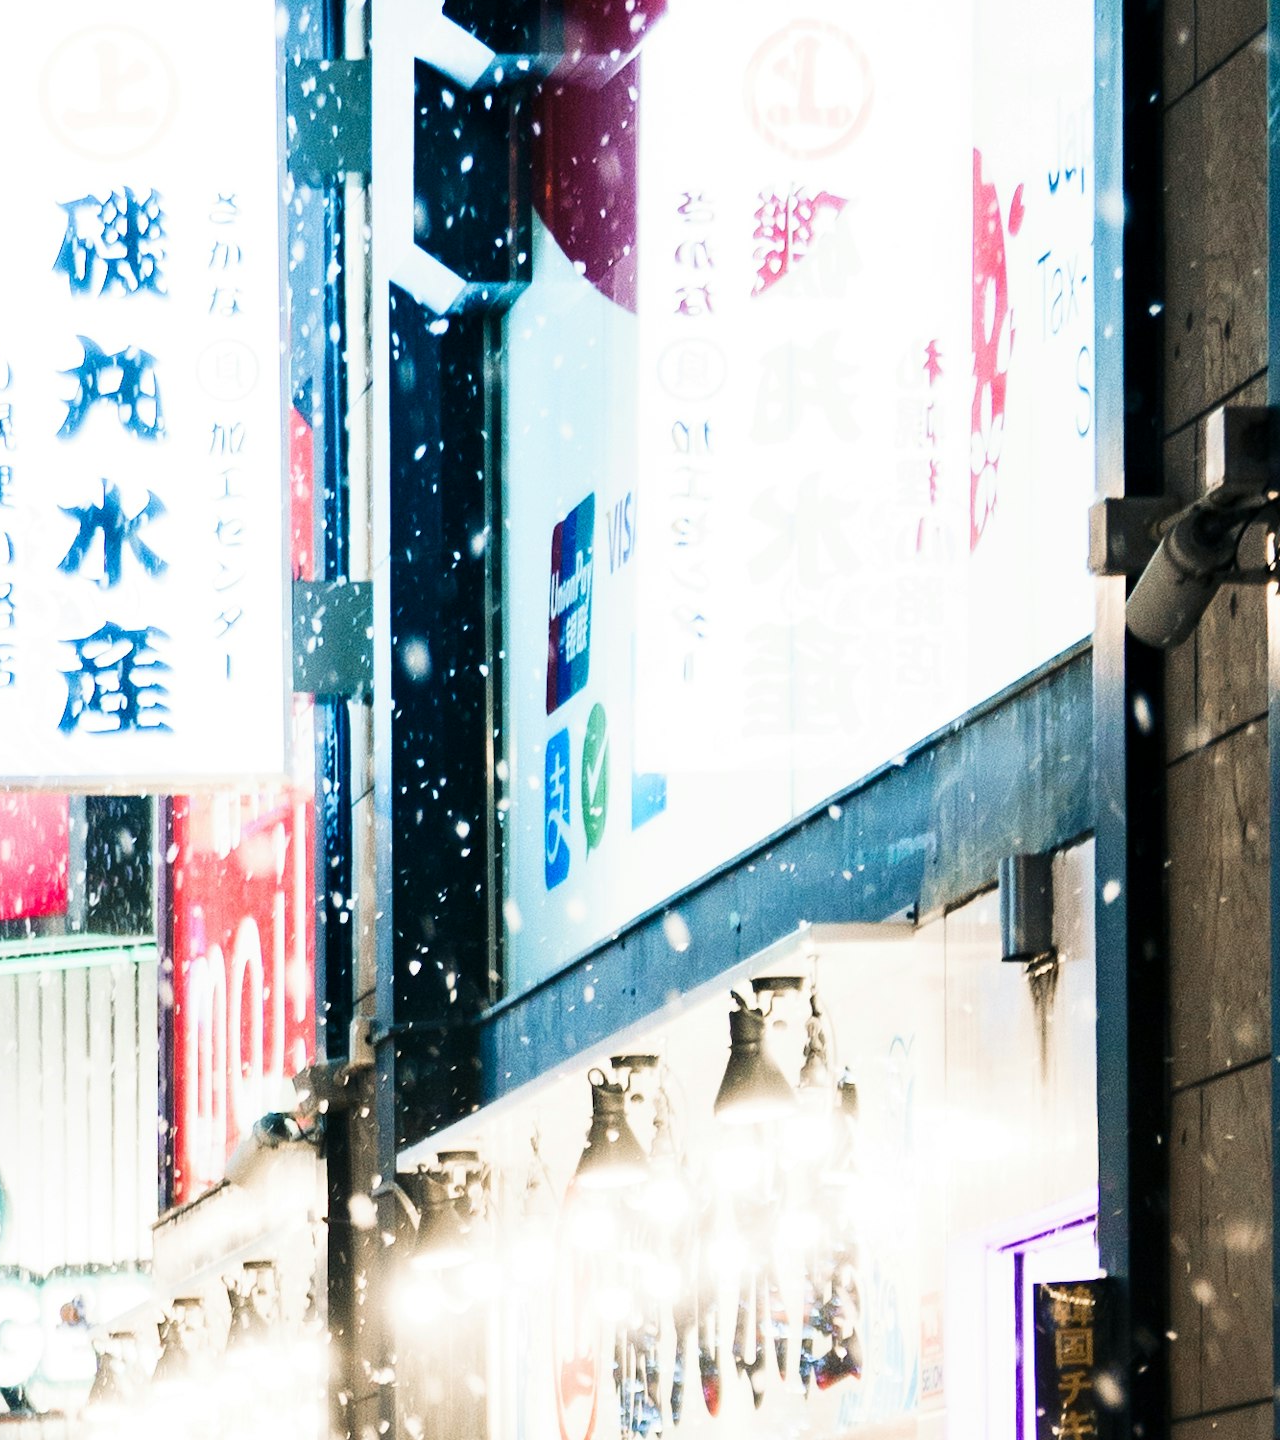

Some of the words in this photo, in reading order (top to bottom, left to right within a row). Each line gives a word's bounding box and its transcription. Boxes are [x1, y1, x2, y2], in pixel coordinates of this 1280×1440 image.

[52, 184, 179, 739] 磯丸水産
[607, 490, 638, 575] VIS
[550, 547, 594, 621] UnionPay
